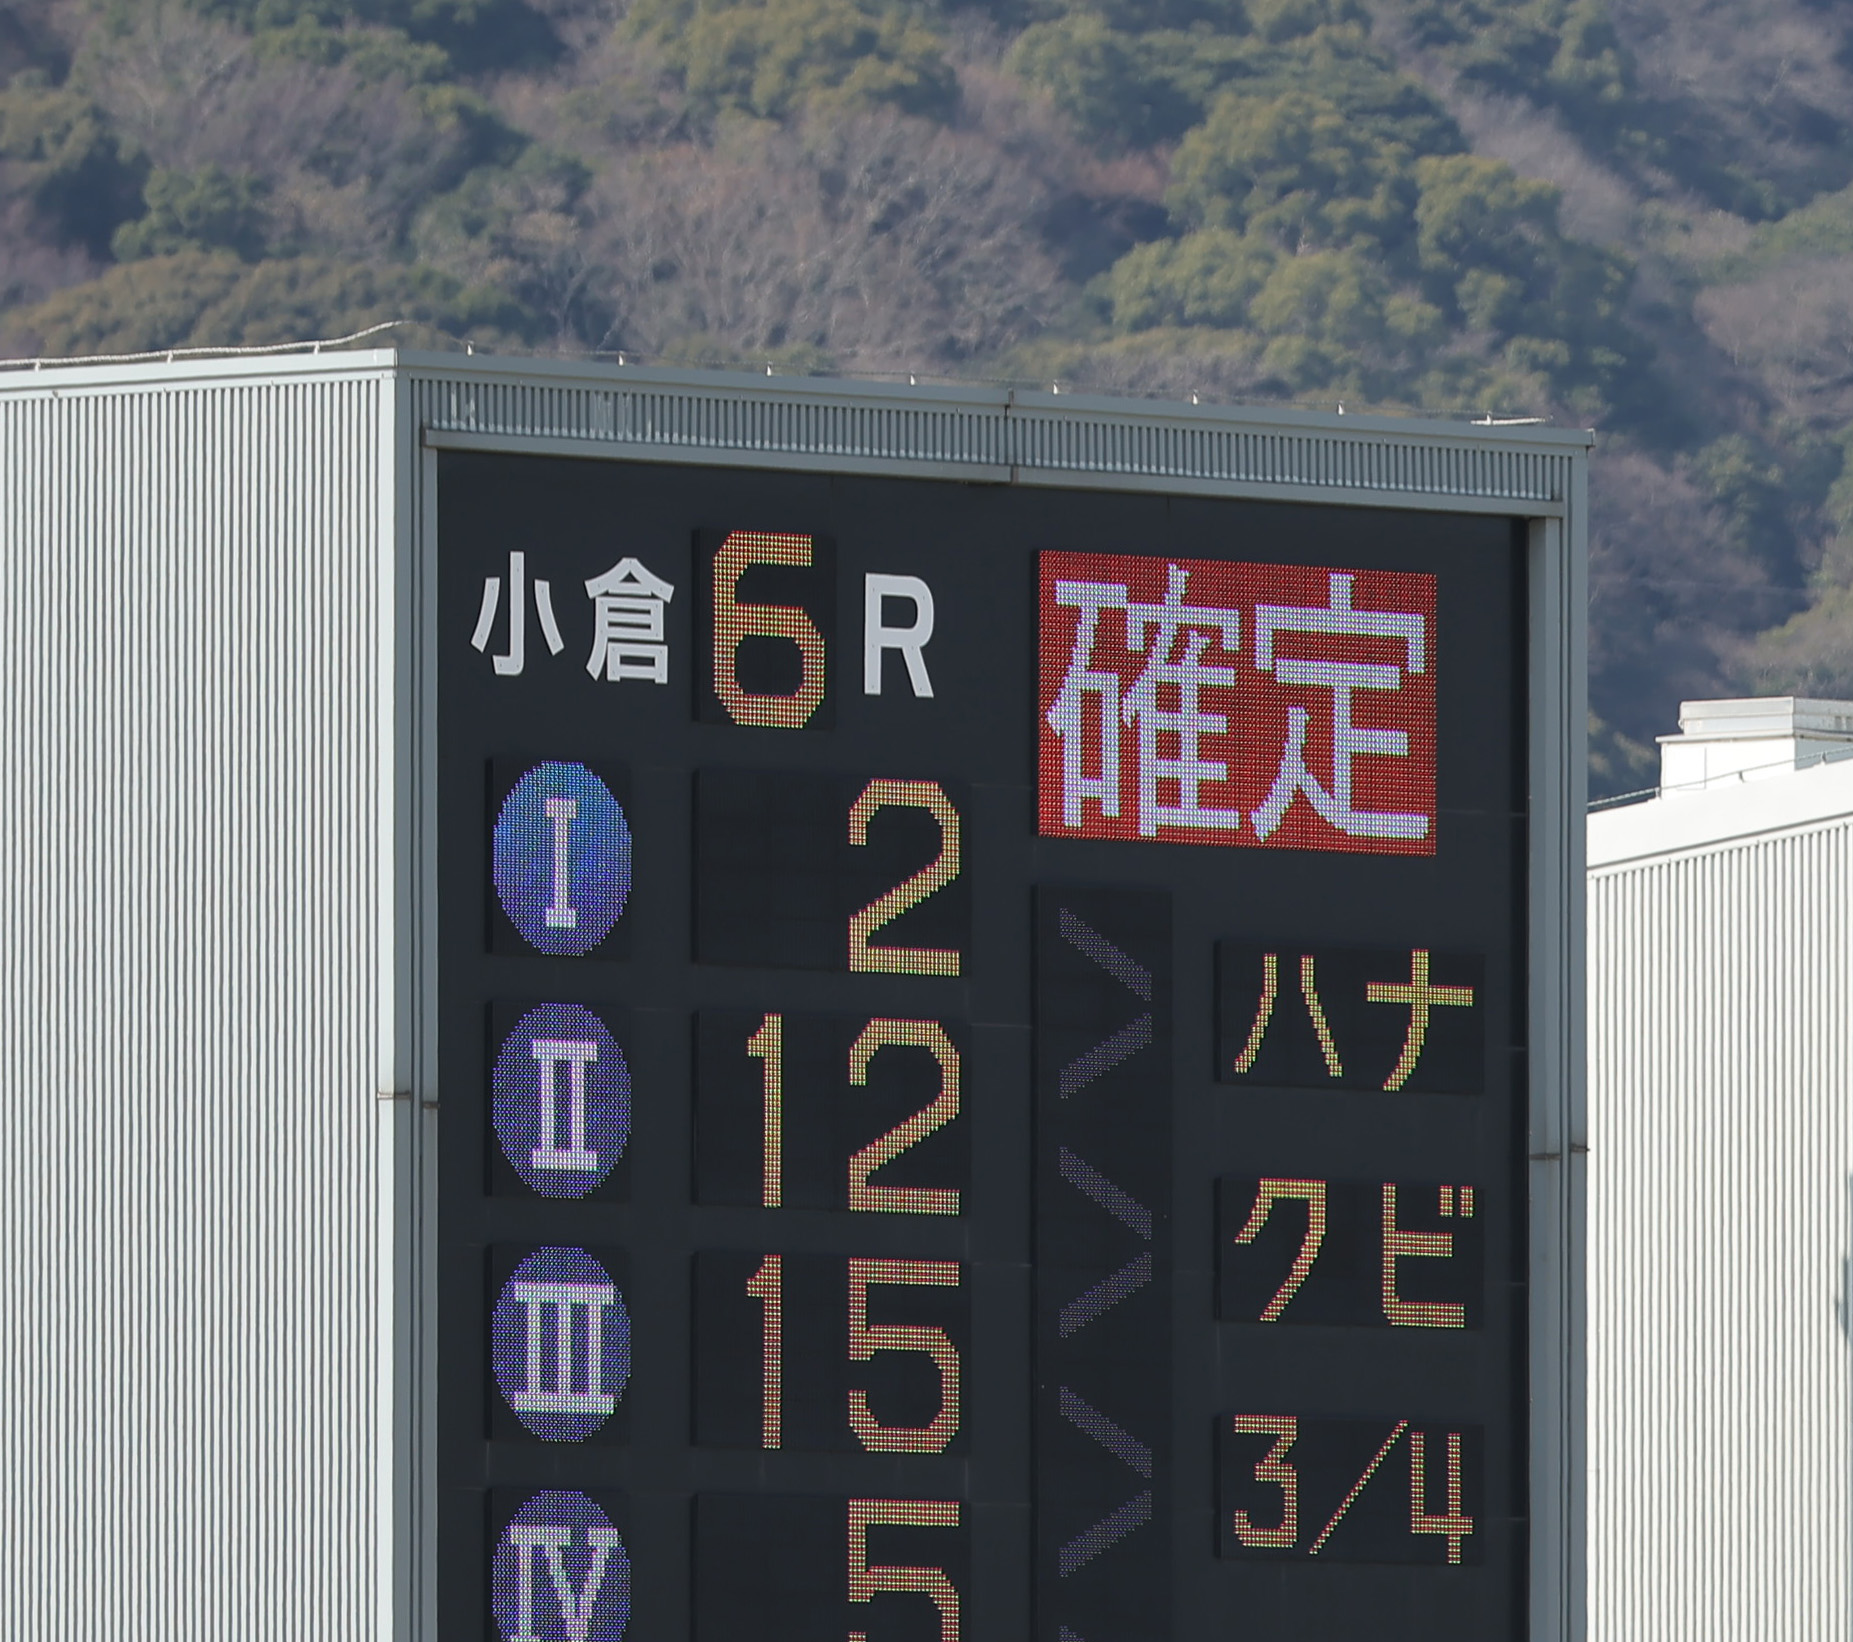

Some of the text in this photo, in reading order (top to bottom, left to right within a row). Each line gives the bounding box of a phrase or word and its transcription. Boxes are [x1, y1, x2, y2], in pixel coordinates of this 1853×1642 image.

[471, 531, 934, 728] 小倉 6 R
[1047, 565, 1429, 840] 確定
[849, 779, 959, 976] 2
[748, 1014, 959, 1215] 12
[1236, 949, 1472, 1091] ハナ
[1235, 1178, 1473, 1327] クビ
[747, 1255, 959, 1453] 15
[1235, 1415, 1472, 1563] 3/4
